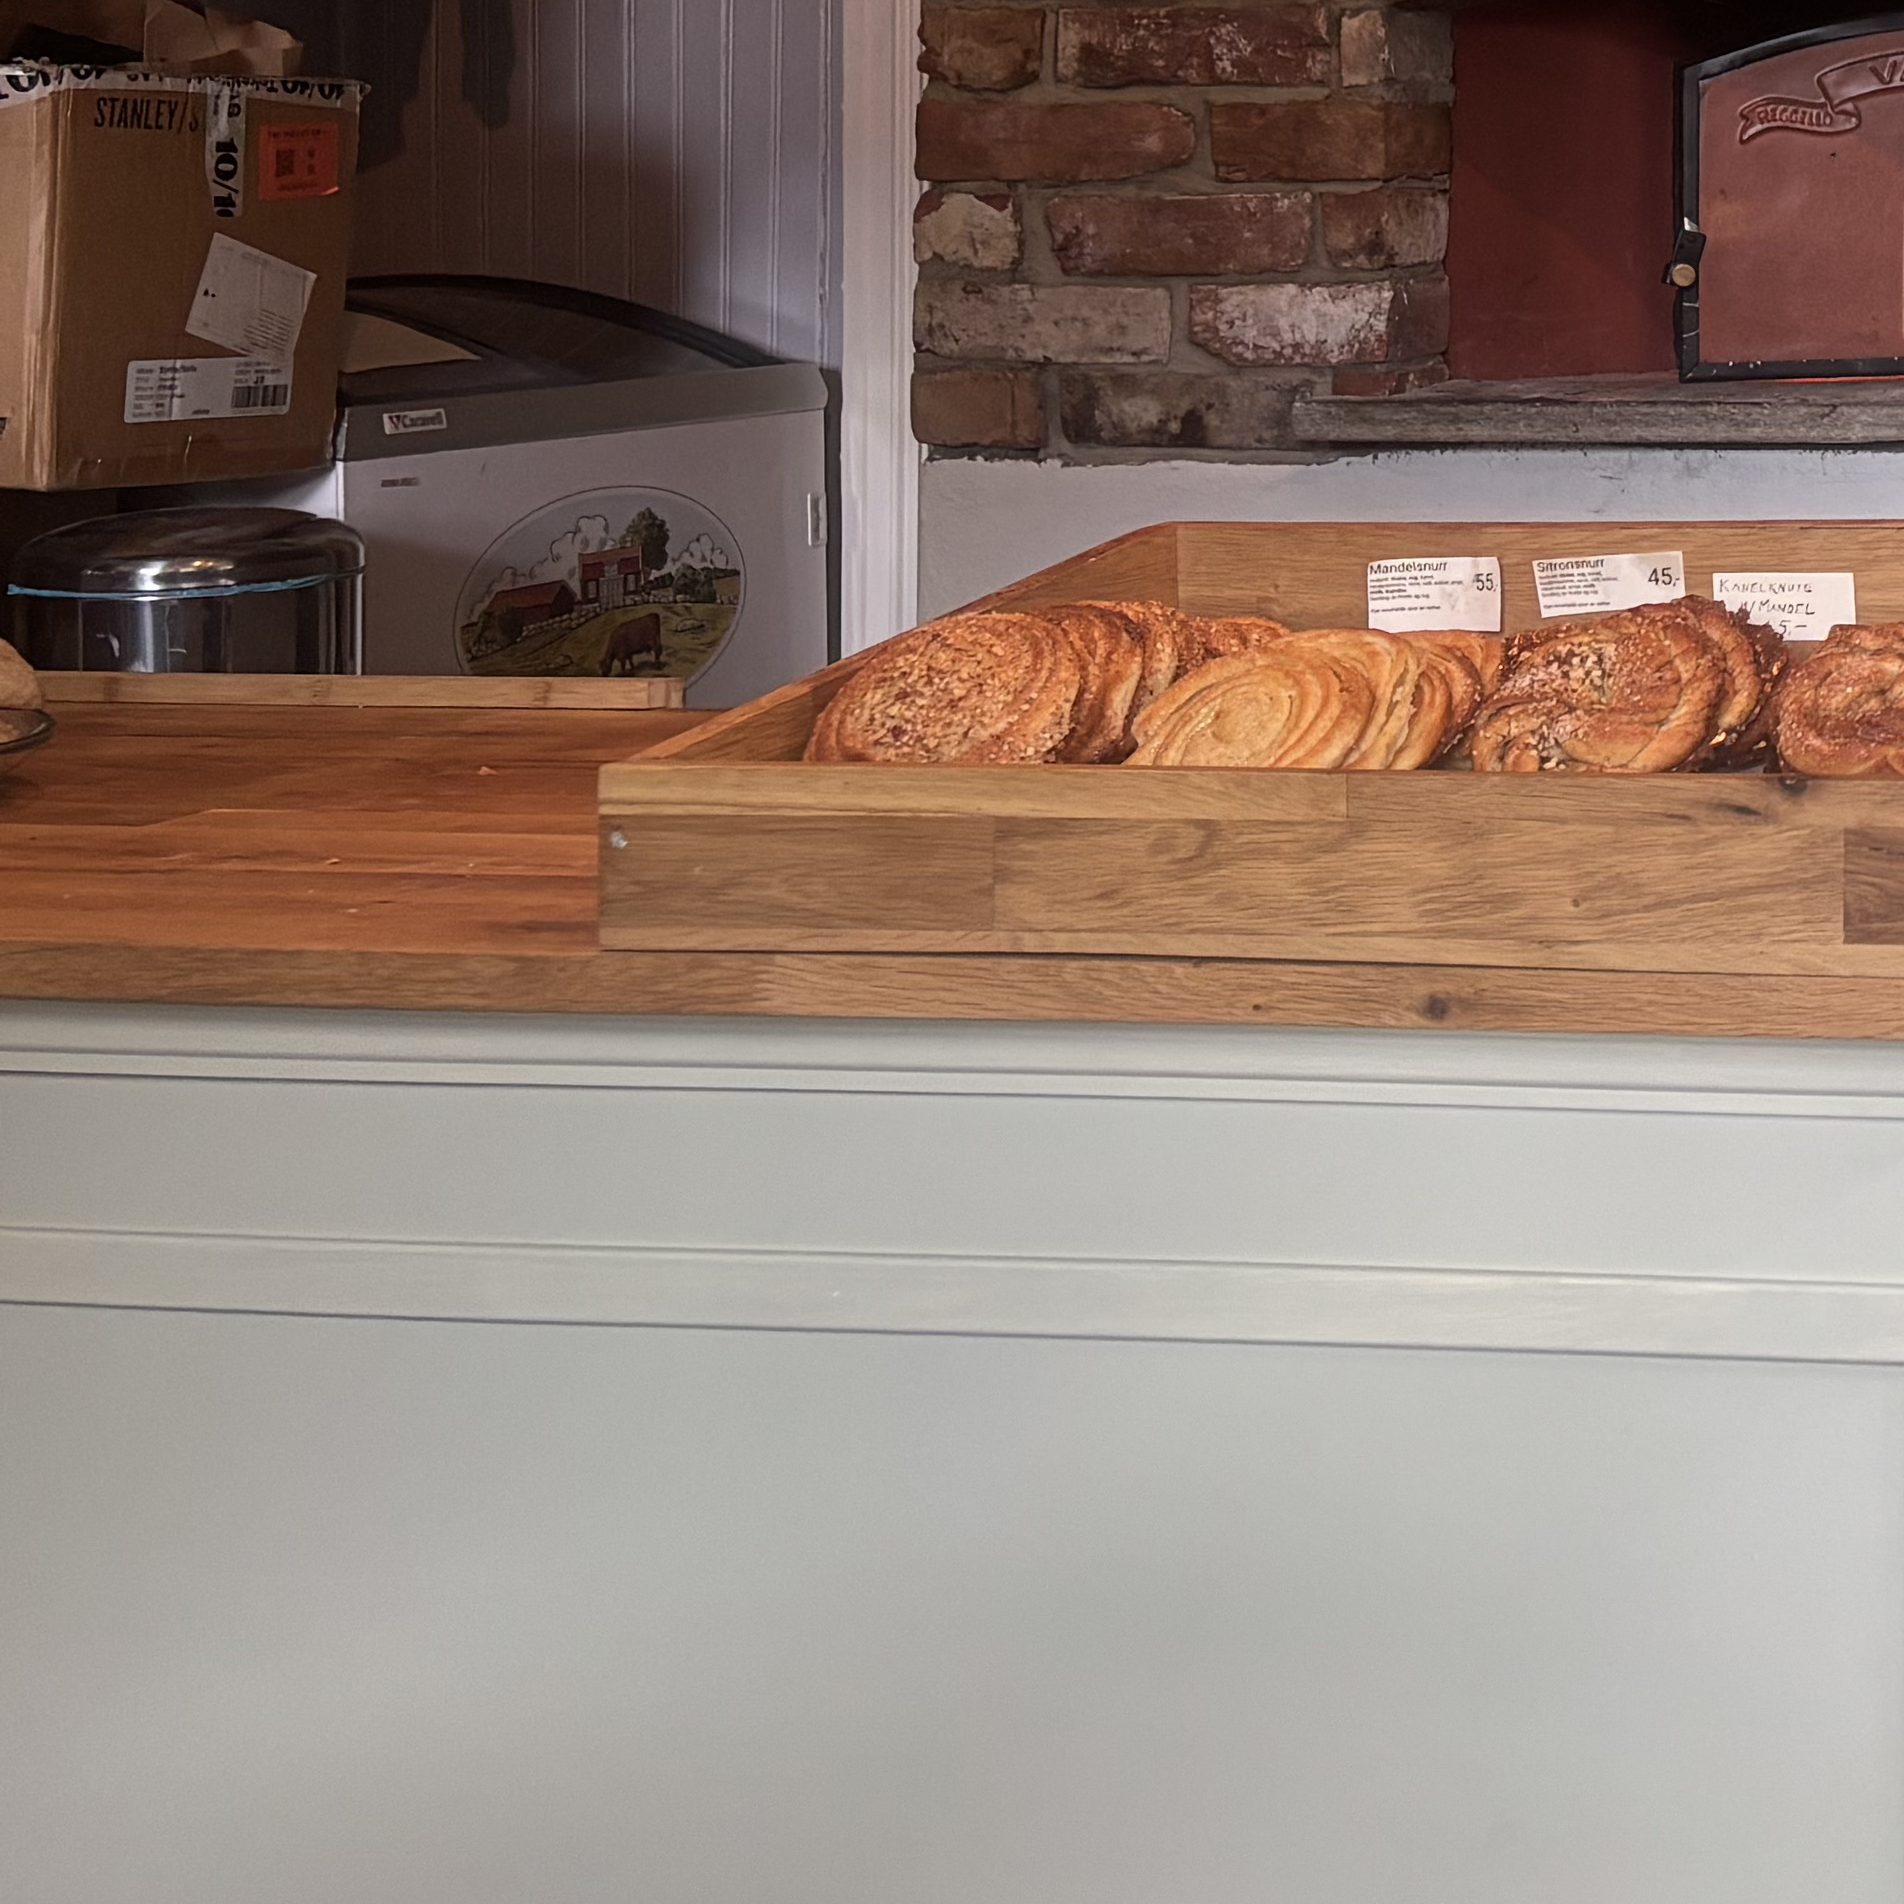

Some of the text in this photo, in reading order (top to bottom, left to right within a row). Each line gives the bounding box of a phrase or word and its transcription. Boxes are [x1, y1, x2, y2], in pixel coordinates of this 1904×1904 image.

[1369, 560, 1447, 575] Mandelsnurr
[1536, 558, 1681, 587] Sitronsnurr 45,-
[1766, 619, 1808, 637] 5,-
